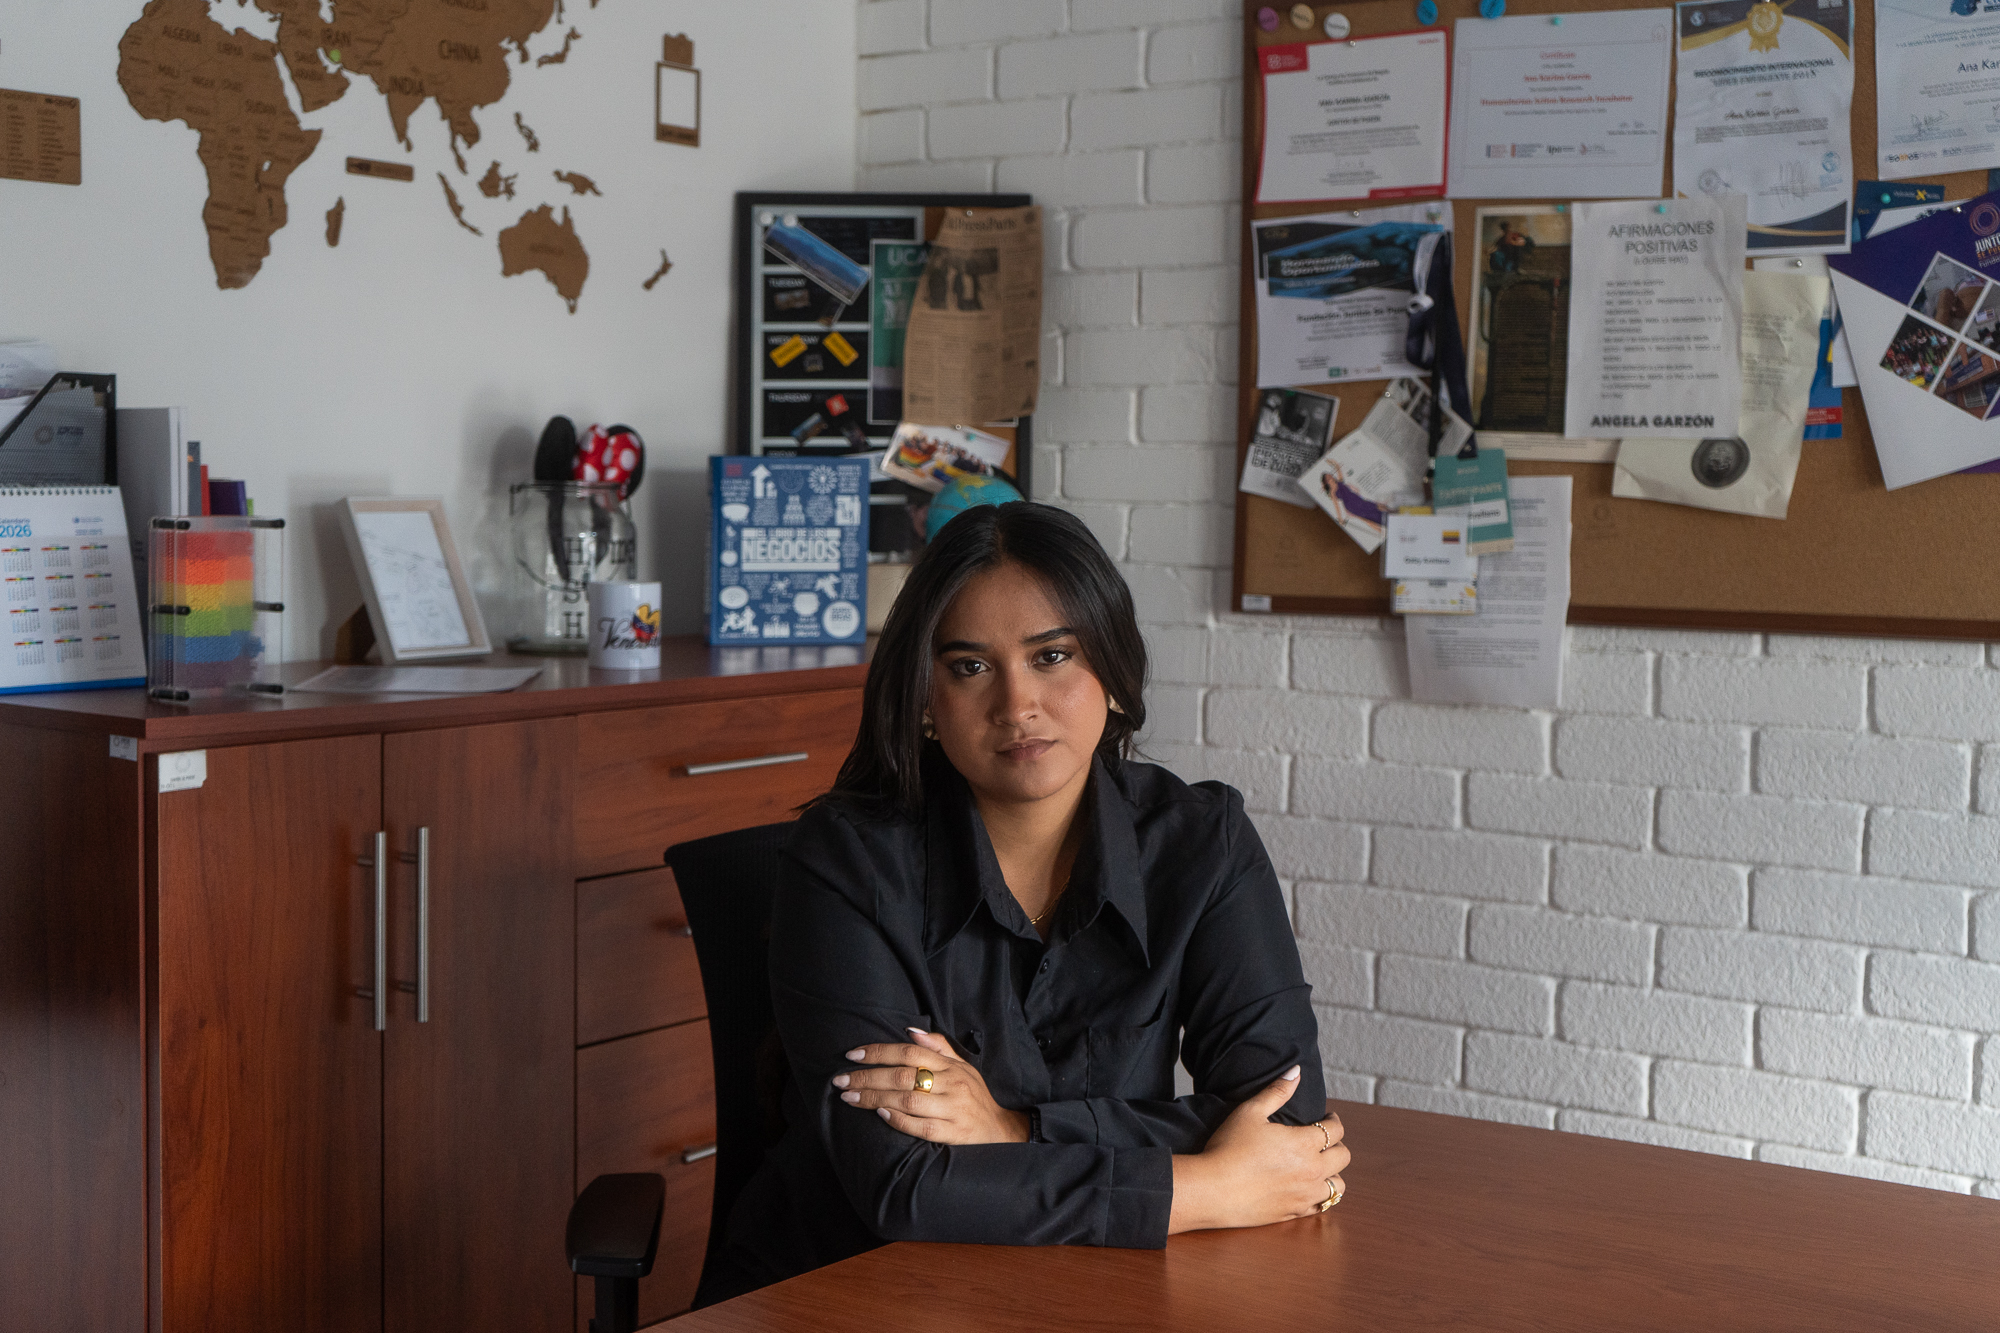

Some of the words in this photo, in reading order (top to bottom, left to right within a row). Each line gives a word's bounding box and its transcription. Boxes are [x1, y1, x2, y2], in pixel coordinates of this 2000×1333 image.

[320, 27, 352, 47] IRAN
[438, 38, 483, 64] CHINA
[1957, 61, 1979, 74] Ana
[389, 75, 426, 97] INDIA
[1608, 220, 1715, 239] AFIRMACIONES
[1624, 238, 1699, 254] POSITIVAS
[768, 277, 807, 288] TUESDAY
[768, 334, 820, 346] WEDDAY
[768, 392, 812, 404] THURSDAY
[1591, 415, 1649, 428] ANGELA
[1652, 412, 1715, 428] GARZÓN
[0, 525, 33, 538] 2026
[742, 540, 841, 562] NEGOCIOS
